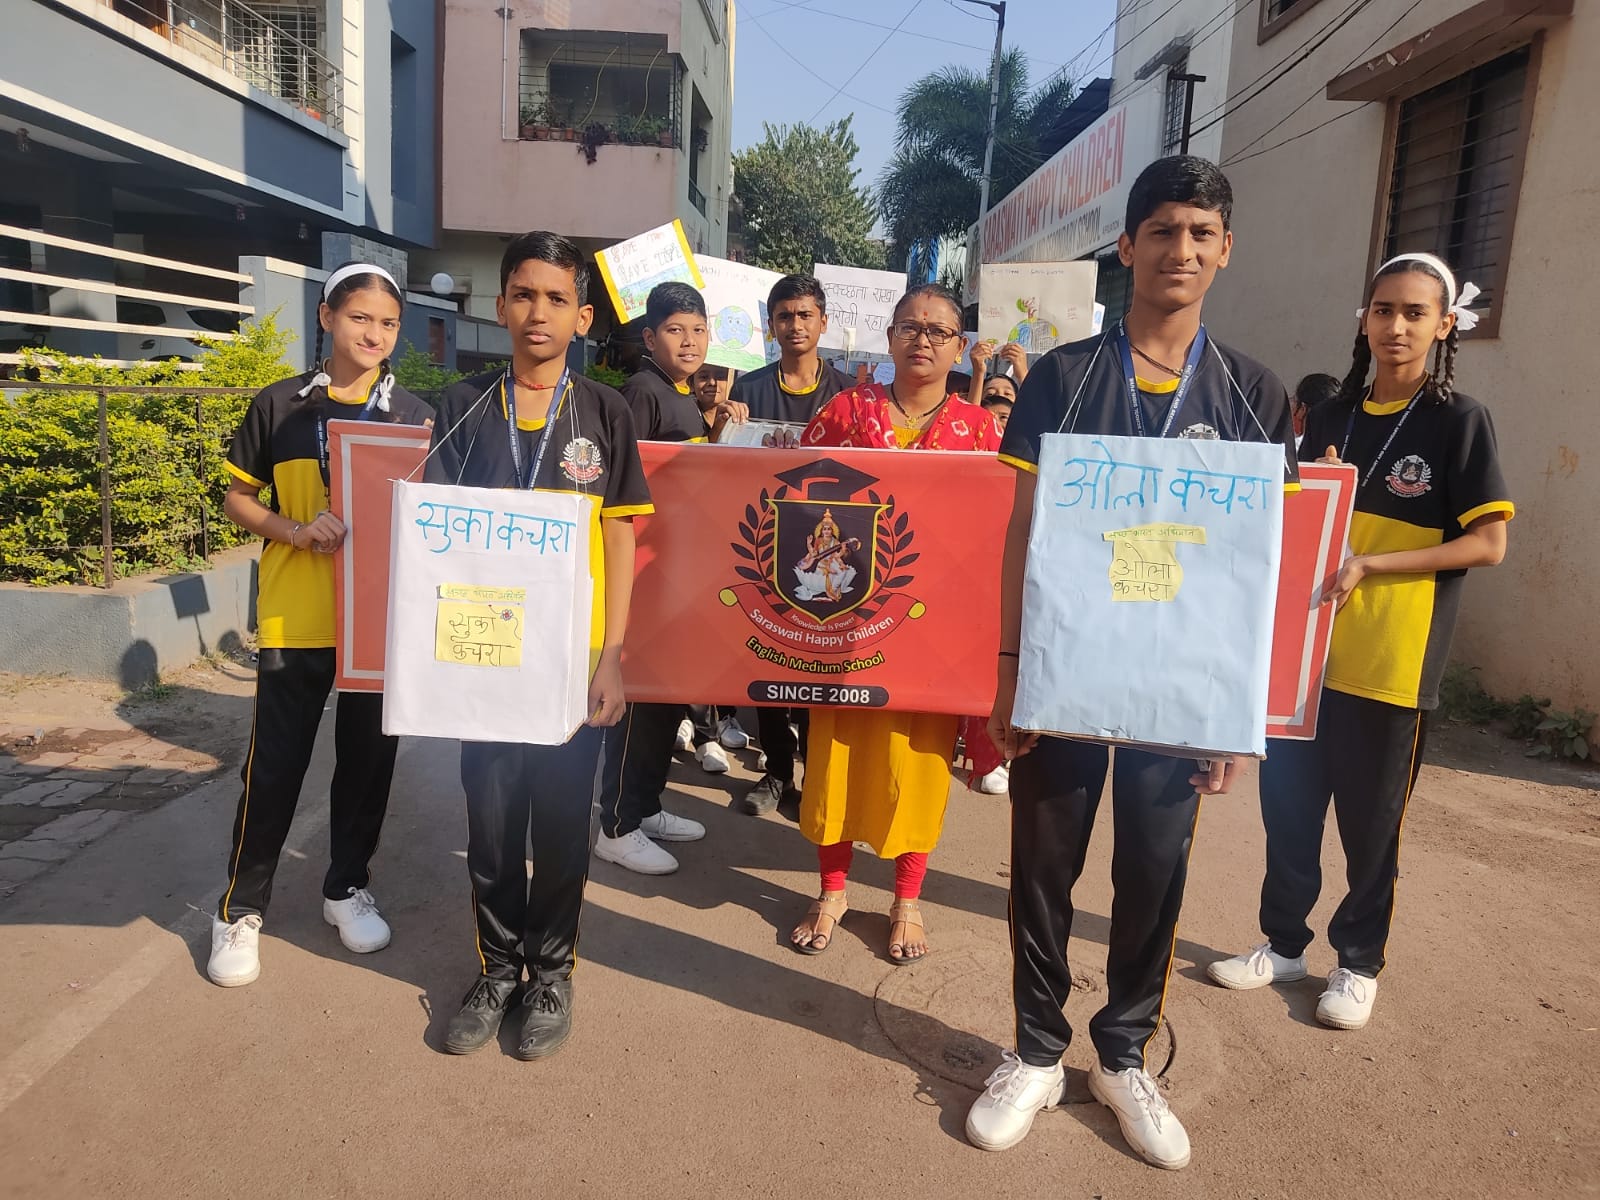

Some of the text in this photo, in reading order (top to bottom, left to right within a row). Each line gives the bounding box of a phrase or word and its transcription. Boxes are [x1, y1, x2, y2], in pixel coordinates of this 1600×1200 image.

[983, 190, 1025, 263] SARASWATI
[1024, 161, 1059, 241] HAPPY
[1058, 106, 1127, 219] CHILDREN
[1077, 204, 1102, 250] SCHOOL
[1056, 440, 1272, 514] ओला कचरा
[415, 501, 576, 555] सुका कचरा
[1113, 579, 1172, 602] कचरा
[449, 613, 497, 641] सुका
[750, 608, 895, 647] Saraswati Happy Children
[790, 613, 827, 631] Knowledge
[834, 616, 855, 630] Power
[452, 641, 516, 666] कचरा
[746, 636, 885, 674] English Medium School
[766, 684, 871, 704] SINCE 2008
